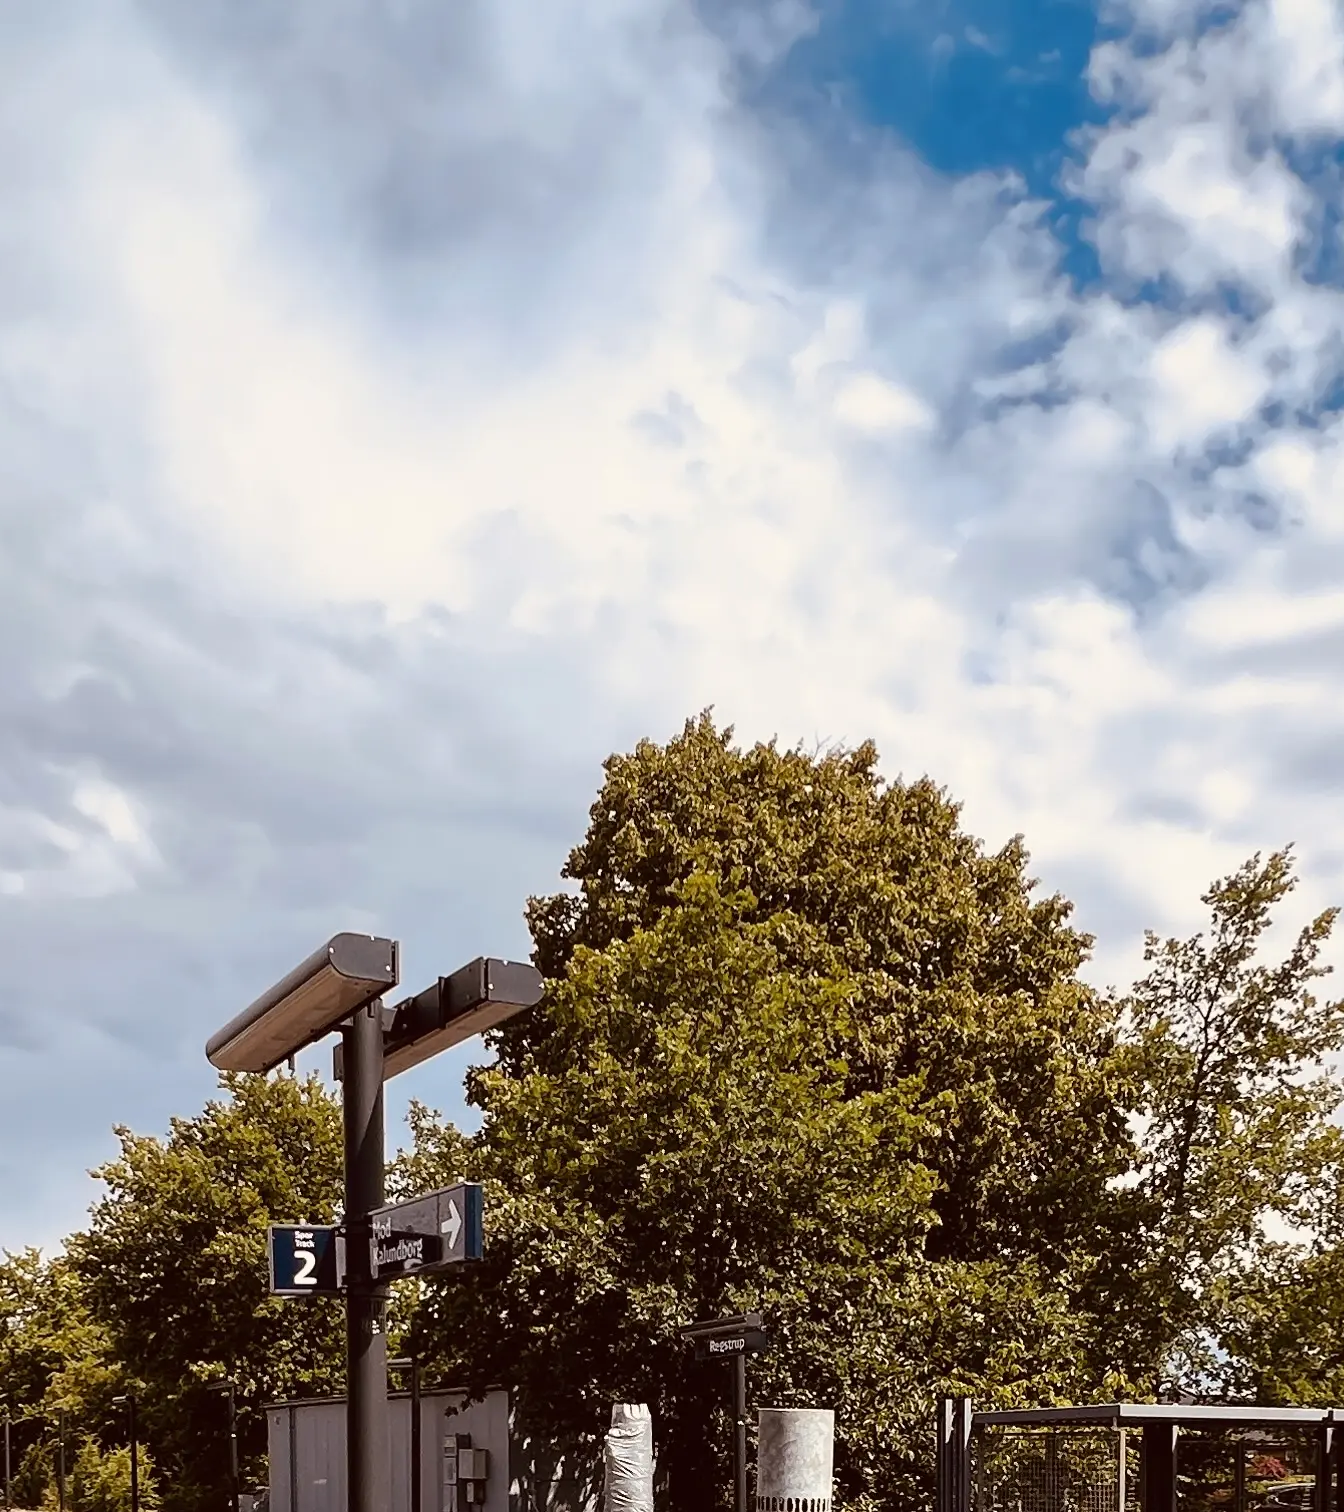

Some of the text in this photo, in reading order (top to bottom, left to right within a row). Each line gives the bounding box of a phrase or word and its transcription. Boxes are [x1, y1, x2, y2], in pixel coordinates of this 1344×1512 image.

[294, 1230, 314, 1240] Spor
[294, 1239, 315, 1248] Track
[372, 1238, 423, 1266] Kalundborg
[293, 1250, 317, 1285] 2
[709, 1338, 745, 1353] Regstrup
